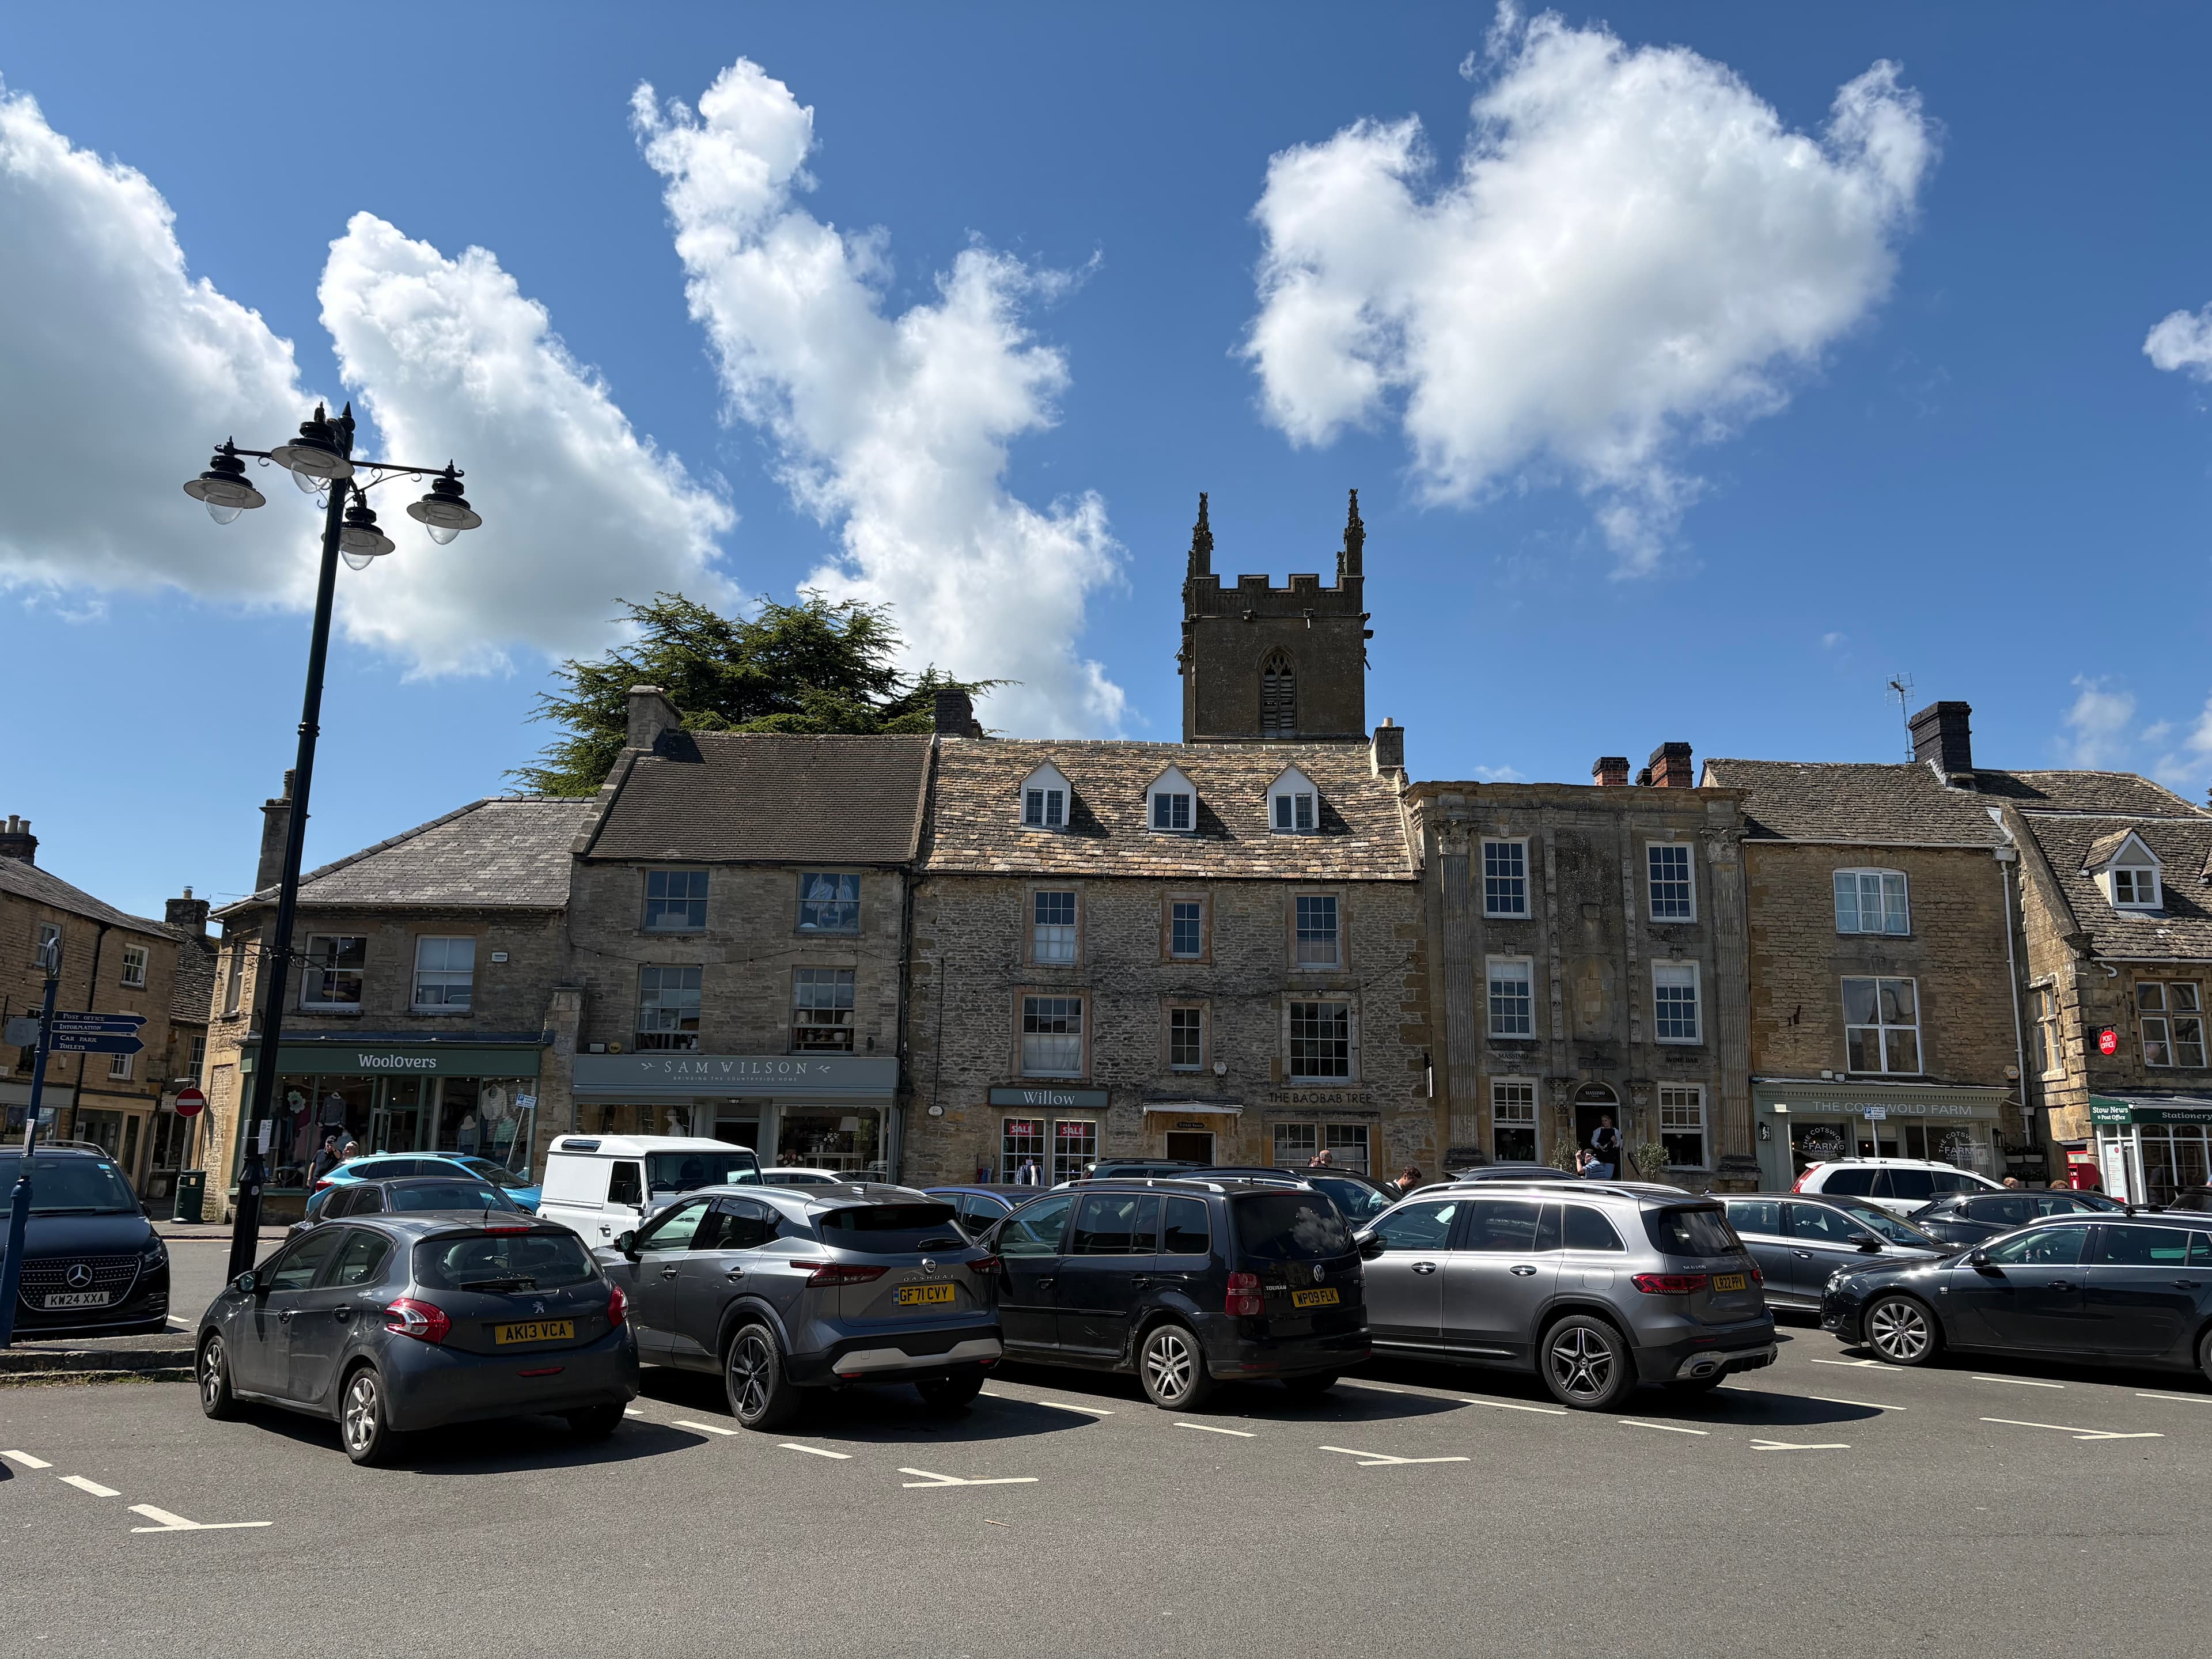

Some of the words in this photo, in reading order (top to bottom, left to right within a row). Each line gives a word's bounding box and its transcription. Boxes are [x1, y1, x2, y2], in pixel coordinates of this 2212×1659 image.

[2101, 1041, 2115, 1049] OFFICE
[358, 1054, 436, 1068] WoolOvers
[664, 1061, 709, 1073] SAM
[721, 1062, 806, 1074] WILSON
[1023, 1090, 1075, 1105] Willow
[1270, 1093, 1289, 1103] THE
[1293, 1093, 1342, 1103] BAOBAB
[1346, 1094, 1372, 1104] TREE
[1812, 1101, 1840, 1111] THE
[1931, 1105, 1972, 1115] FARM
[2162, 1112, 2212, 1120] Stationery
[1011, 1125, 1033, 1133] SALE
[1062, 1127, 1084, 1135] SALE
[1803, 1135, 1811, 1149] THE
[1810, 1127, 1844, 1150] COTSWOLD
[1715, 1278, 1732, 1290] LR22
[1732, 1276, 1742, 1287] PPY
[50, 1295, 79, 1305] KW24
[83, 1293, 104, 1304] XXA
[900, 1288, 924, 1302] GF71
[927, 1286, 948, 1300] CVY
[1297, 1291, 1320, 1305] WP09
[1321, 1290, 1336, 1302] FLK
[506, 1325, 537, 1341] AK13
[541, 1323, 566, 1337] VCA
